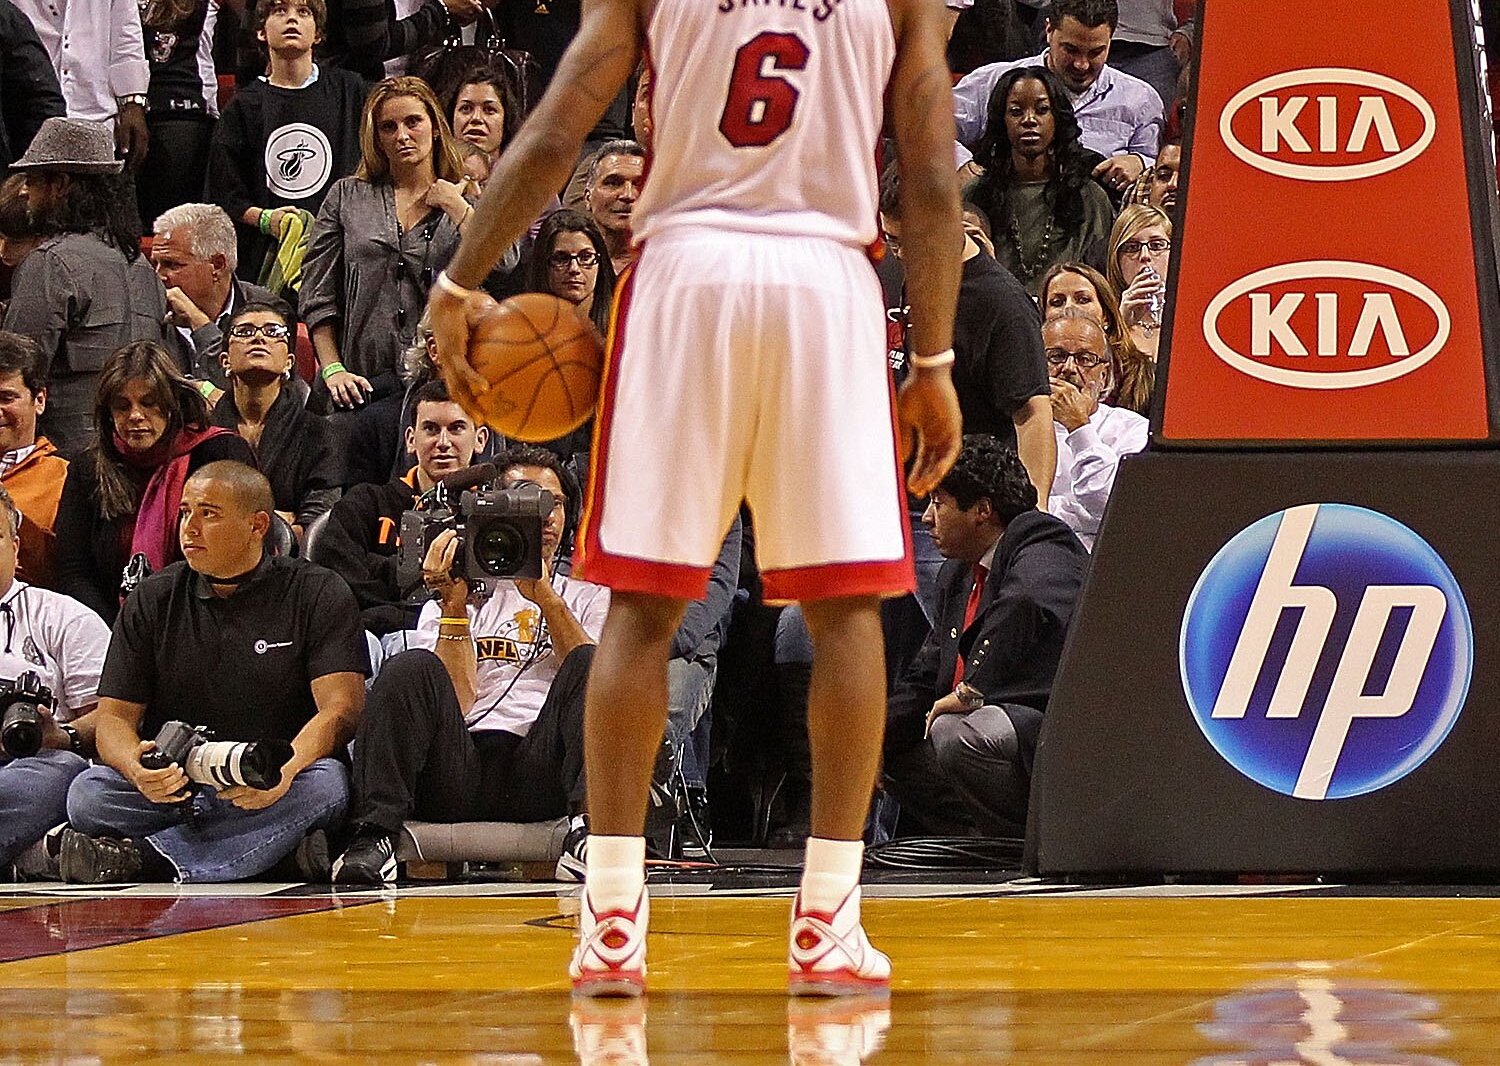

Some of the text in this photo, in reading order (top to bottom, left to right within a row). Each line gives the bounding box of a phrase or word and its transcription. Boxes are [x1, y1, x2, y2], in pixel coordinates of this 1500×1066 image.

[717, 30, 811, 148] 6
[1258, 96, 1401, 153] KIA
[1248, 292, 1411, 356] KIA
[1211, 503, 1448, 801] hp
